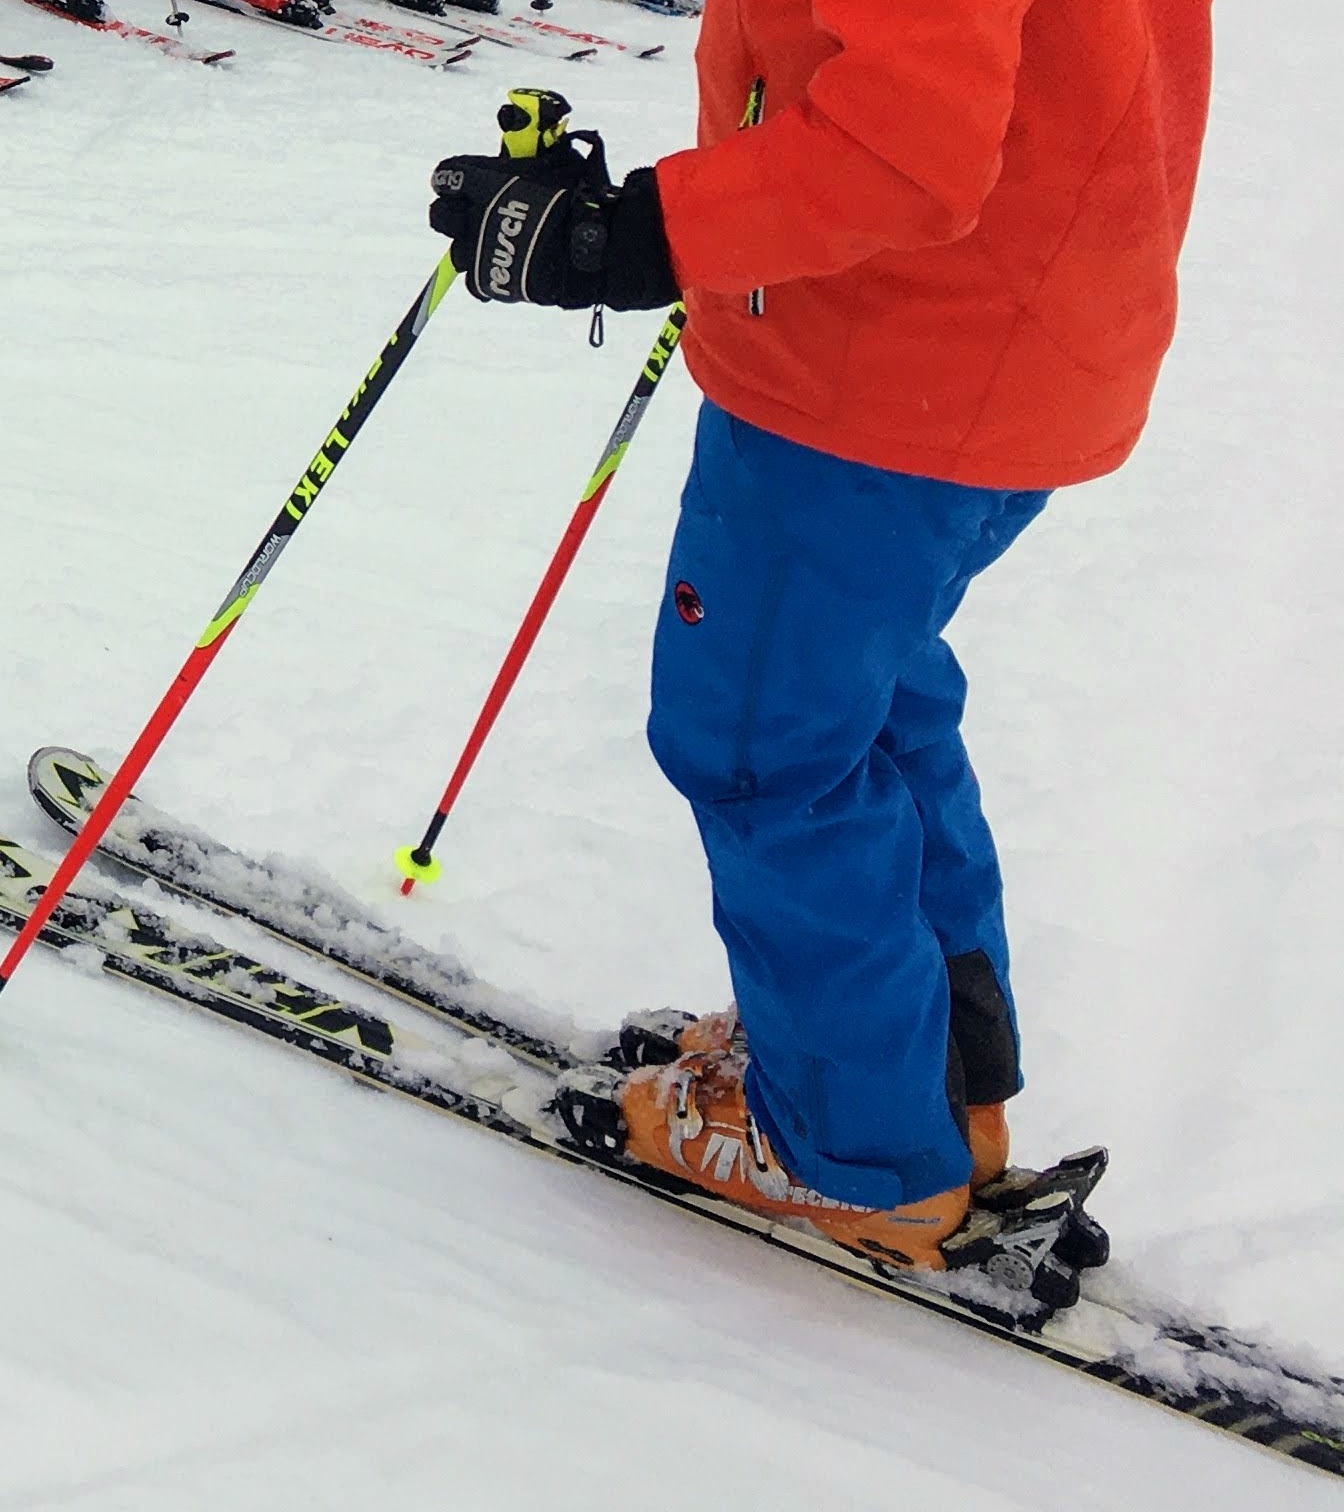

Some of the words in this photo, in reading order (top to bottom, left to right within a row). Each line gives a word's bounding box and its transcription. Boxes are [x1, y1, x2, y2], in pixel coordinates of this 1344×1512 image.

[489, 200, 530, 297] reusch
[285, 426, 350, 522] LEKI
[239, 533, 282, 598] WORLDCUP
